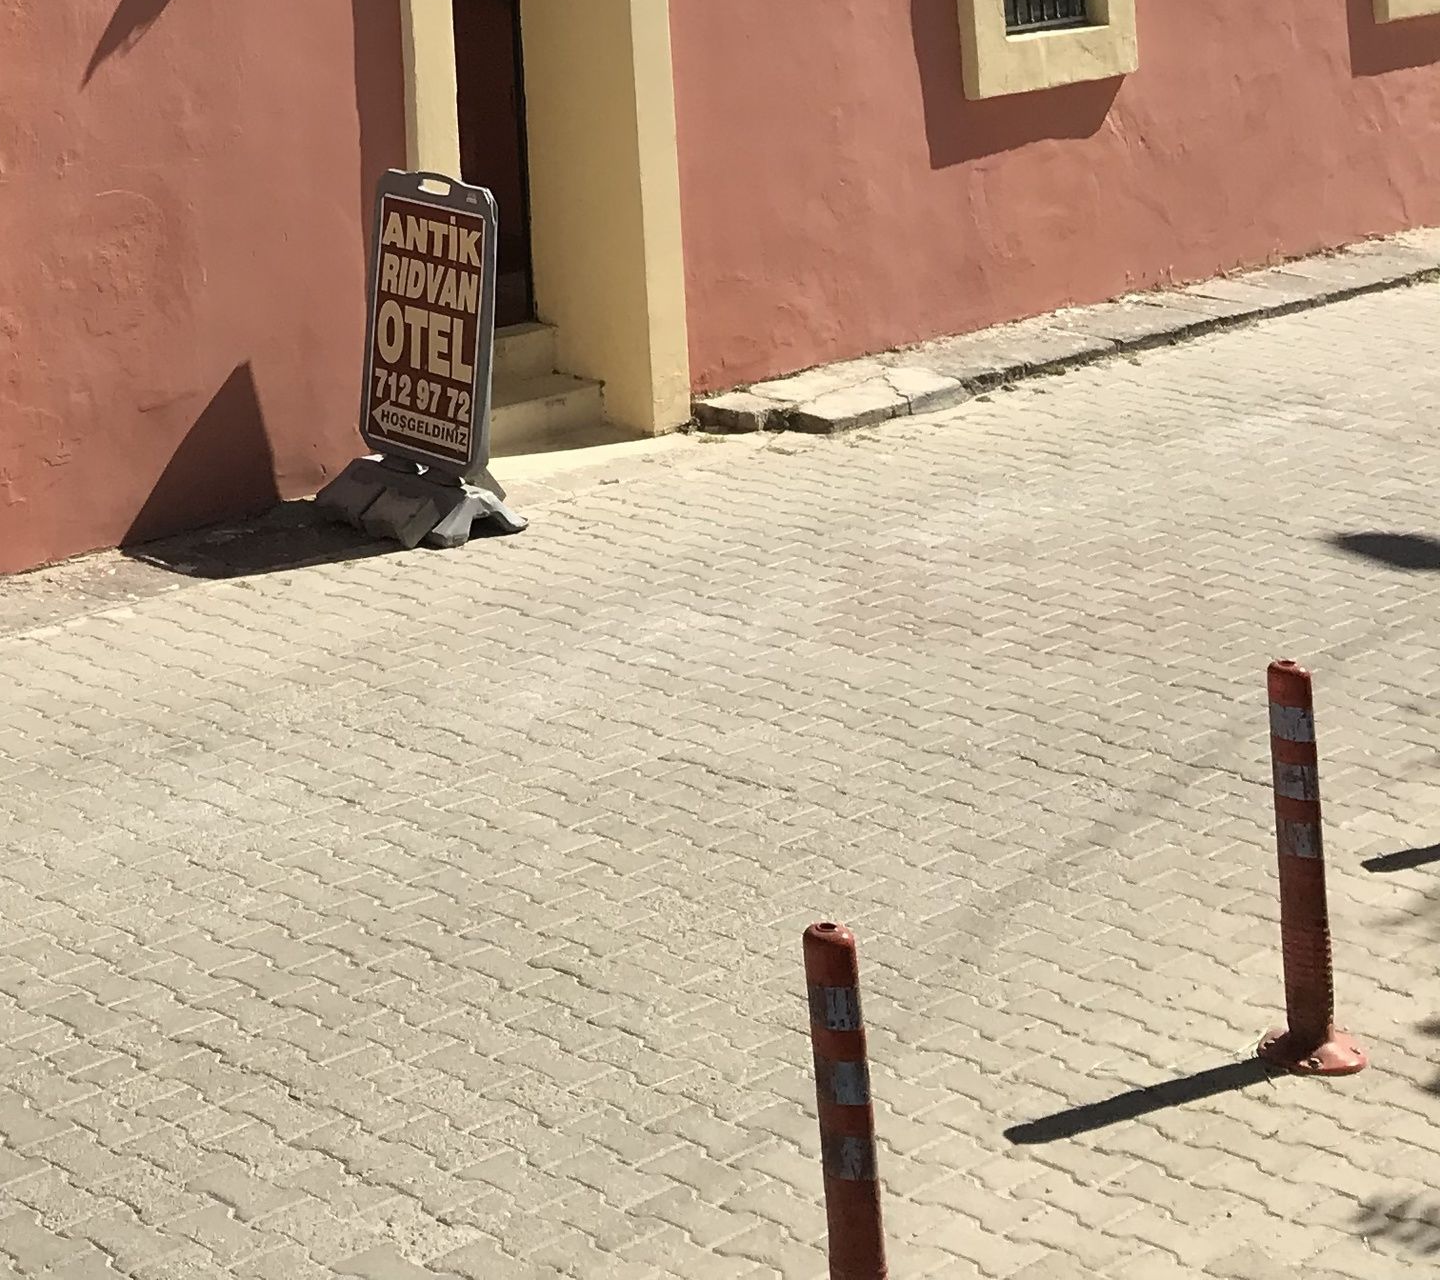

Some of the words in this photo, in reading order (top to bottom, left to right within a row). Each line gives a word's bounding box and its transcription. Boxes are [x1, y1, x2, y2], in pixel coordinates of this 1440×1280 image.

[382, 212, 481, 267] ANTİK
[381, 252, 478, 314] RIDVAN
[377, 299, 473, 384] OTEL
[375, 367, 412, 406] 712
[416, 378, 442, 413] 97
[447, 386, 471, 423] 72
